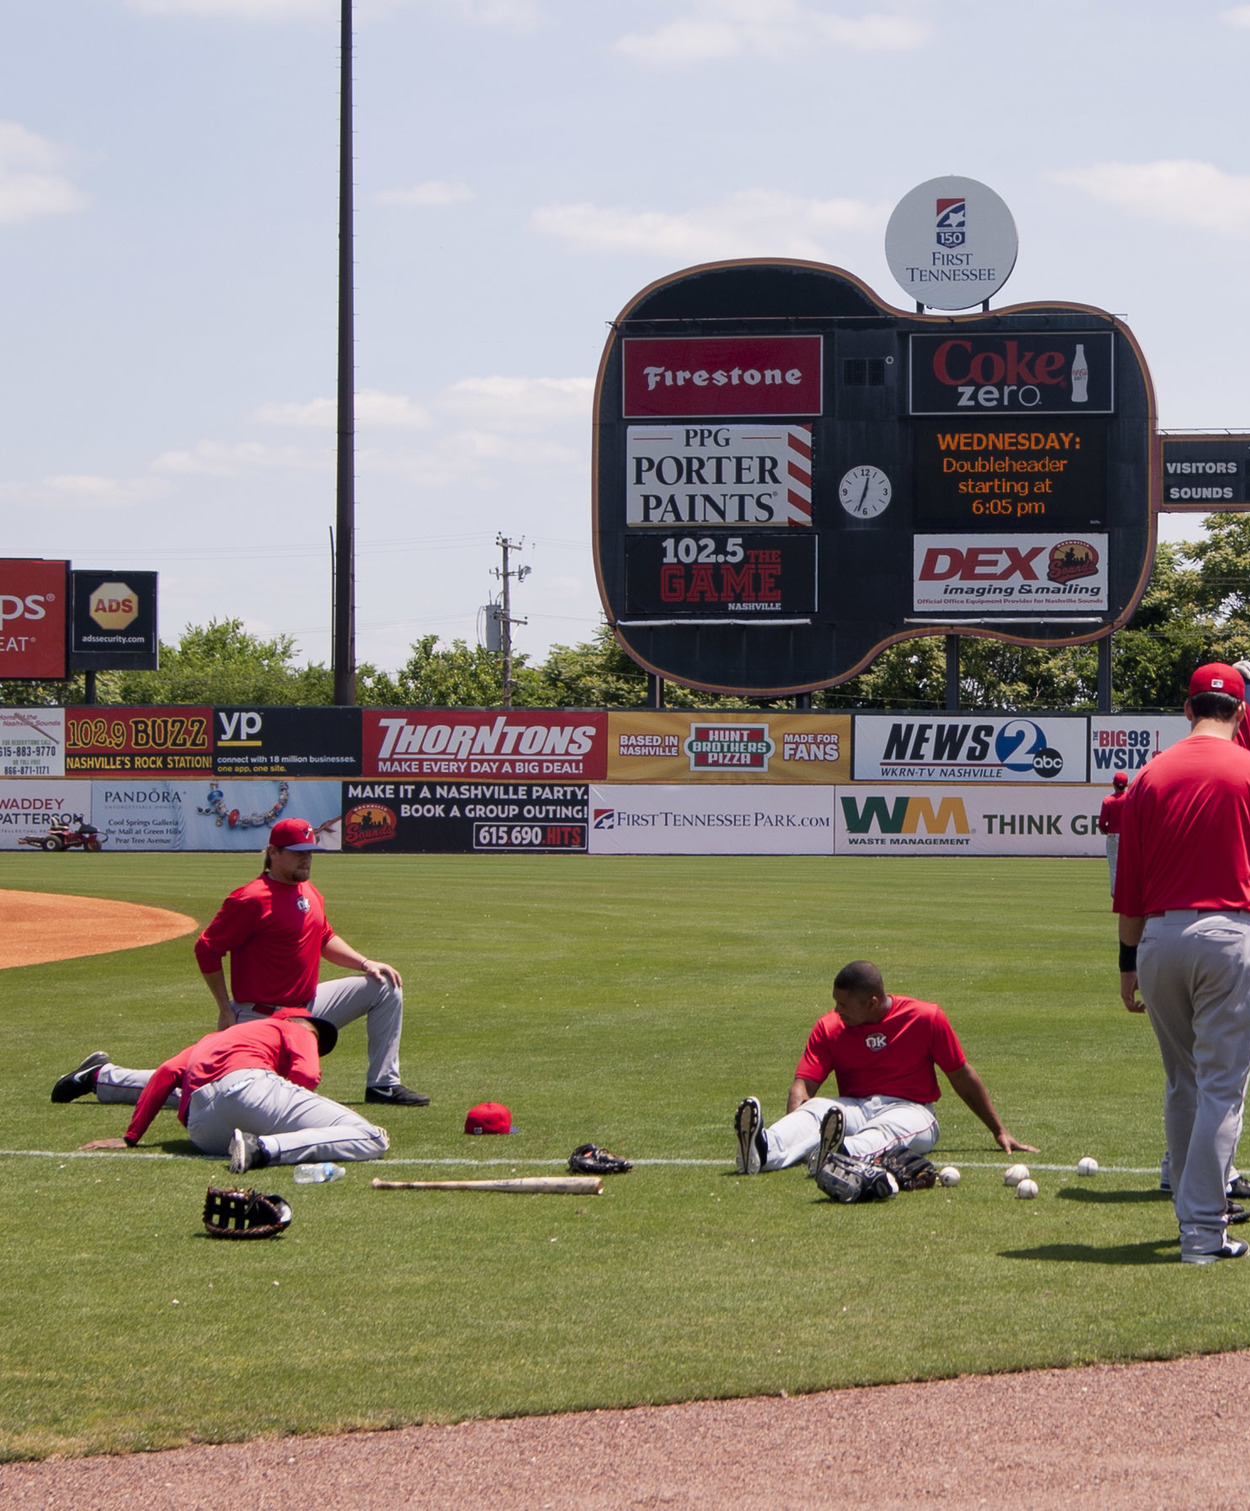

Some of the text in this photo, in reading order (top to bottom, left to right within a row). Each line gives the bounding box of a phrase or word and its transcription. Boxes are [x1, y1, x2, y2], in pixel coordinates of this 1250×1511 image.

[939, 232, 962, 244] 150
[933, 340, 1066, 386] Coke
[643, 366, 802, 391] Firestone
[957, 385, 1041, 407] zero
[684, 428, 731, 447] PPG
[937, 432, 1081, 450] WEDNESDAY:
[633, 455, 782, 485] PORTER
[943, 456, 1068, 473] Doubleheader
[1166, 463, 1237, 474] VISITORS
[958, 478, 1053, 496] starting at
[1170, 487, 1233, 499] SOUNDS
[640, 493, 775, 523] PAINTS
[972, 499, 1045, 517] 6:05 pm
[662, 537, 744, 563] 102.5
[747, 550, 781, 563] THE
[919, 547, 1048, 581] DEX
[660, 564, 782, 602] GAME
[943, 584, 1015, 597] imaging
[94, 599, 133, 613] ADS
[728, 603, 781, 611] NASHVILLE
[82, 635, 145, 644] adssecurity.com
[219, 711, 262, 740] yp
[67, 718, 207, 749] 102.9 BUZZ
[378, 716, 596, 759] THORNTONS
[620, 735, 678, 746] BASED IN
[708, 730, 750, 741] HUNT
[784, 734, 838, 743] MADE FOR
[692, 742, 767, 753] BROTHERS
[883, 721, 1040, 764] NEWS 2
[620, 747, 678, 756] NASHVILLE
[707, 753, 751, 764] PIZZA
[783, 744, 839, 761] FANS
[1093, 748, 1149, 769] WSIX
[67, 756, 213, 769] NASHVILLE'S ROCK STATION!
[250, 755, 267, 763] with
[269, 755, 279, 763] 18
[281, 755, 307, 763] million
[309, 755, 356, 763] businesses.
[1033, 755, 1063, 768] abc
[378, 762, 583, 774] MAKE EVERY DAY A BIG DEAL!
[881, 768, 1003, 778] WKRN-TV NASHVILLE
[105, 790, 182, 803] PANDORA
[349, 785, 588, 799] MAKE IT A NASHVILLE PARTY.
[401, 805, 445, 817] BOOK
[450, 805, 460, 817] A
[465, 805, 518, 818] GROUP
[523, 805, 588, 818] OUTING!
[841, 797, 970, 834] WM
[126, 819, 150, 827] Springs
[983, 814, 1062, 835] THINK
